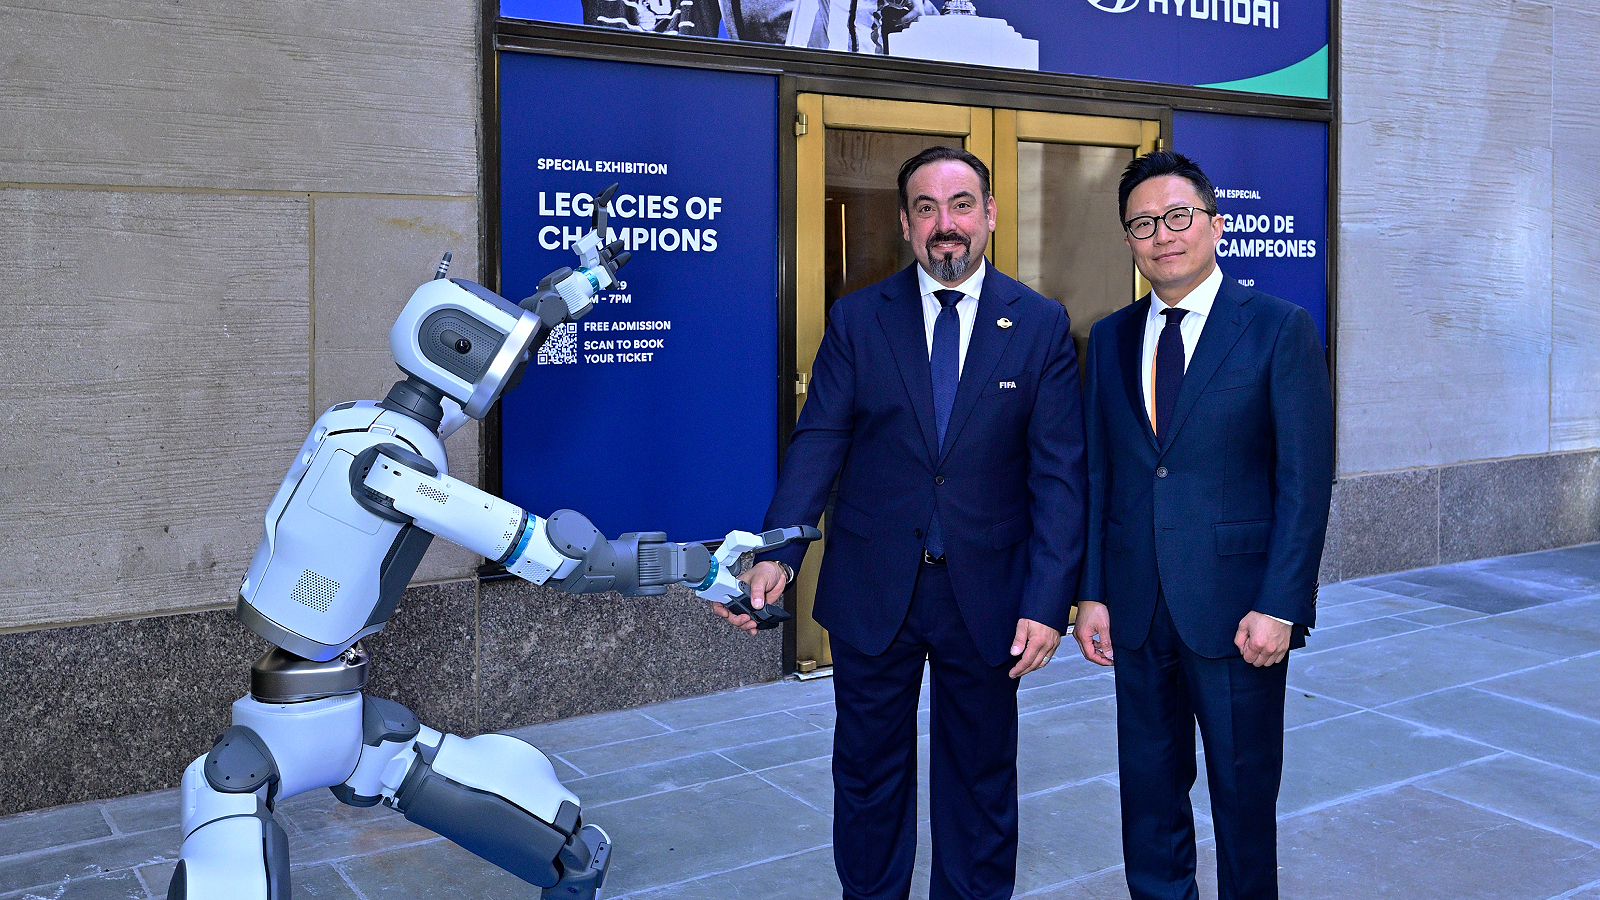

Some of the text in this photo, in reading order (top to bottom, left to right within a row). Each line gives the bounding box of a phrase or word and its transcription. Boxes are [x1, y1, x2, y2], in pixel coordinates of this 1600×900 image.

[537, 158, 668, 175] SPECIAL EXHIBITION
[1226, 190, 1261, 199] ESPECIAL
[685, 196, 722, 220] OF
[1216, 213, 1294, 233] GADO DE
[538, 225, 718, 252] CHMPIONS
[1215, 239, 1317, 258] CAMPEONES
[609, 294, 631, 303] 7PM
[584, 321, 671, 331] FREE ADMISSION
[584, 339, 664, 350] SCAN TO BOOK
[584, 353, 653, 363] YOUR TICKET
